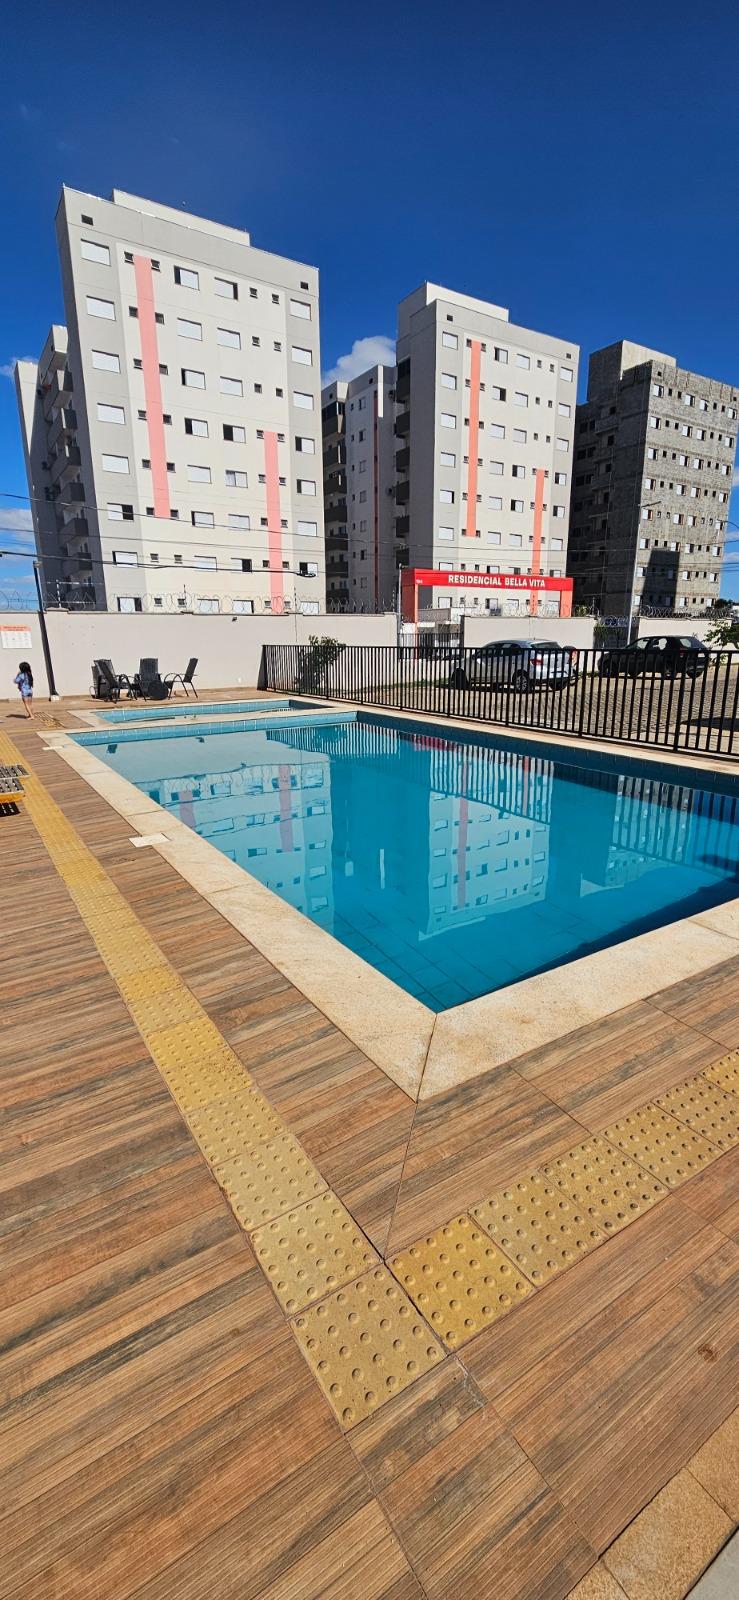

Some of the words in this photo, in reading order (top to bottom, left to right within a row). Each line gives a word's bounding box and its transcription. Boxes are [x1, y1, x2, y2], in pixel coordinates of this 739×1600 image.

[448, 574, 502, 586] RESIDENCIAL
[504, 577, 528, 587] BELLA
[529, 579, 546, 588] VITA
